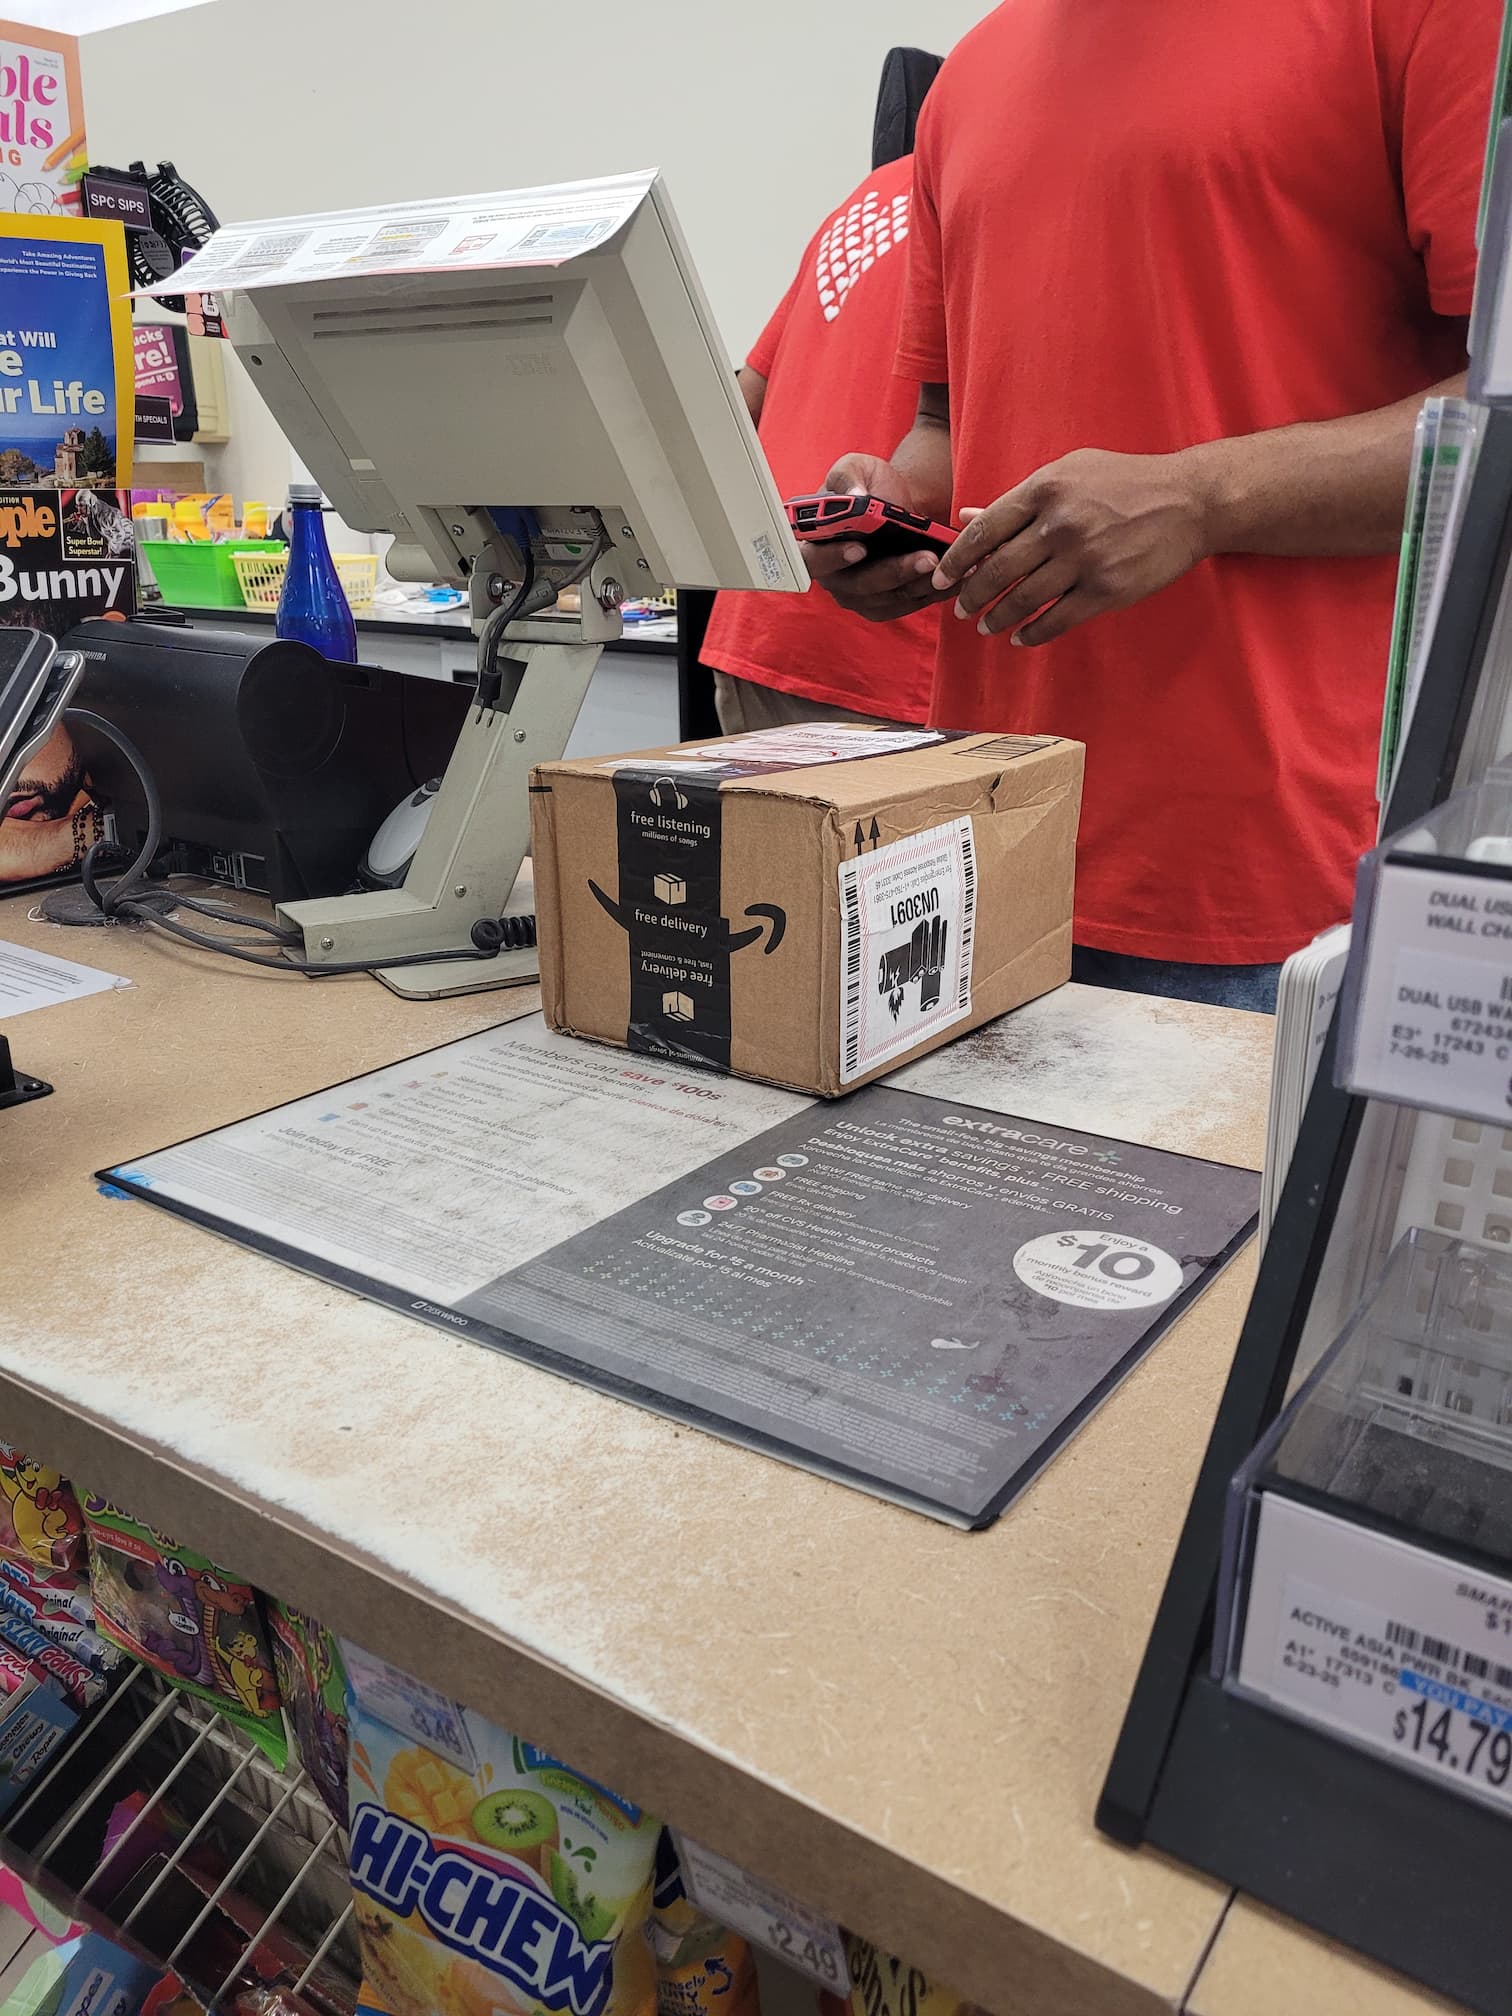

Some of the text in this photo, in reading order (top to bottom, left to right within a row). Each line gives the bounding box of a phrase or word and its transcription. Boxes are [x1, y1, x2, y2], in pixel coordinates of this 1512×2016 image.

[91, 193, 145, 213] SPC SIPS
[22, 250, 96, 262] Take Amazing Adventures
[62, 262, 97, 270] Destinations
[19, 331, 56, 348] Will
[28, 380, 105, 414] Life
[142, 415, 168, 424] SPECIALS
[66, 536, 87, 546] Super
[68, 546, 102, 555] Superstar!
[0, 554, 124, 608] Bunny
[631, 810, 712, 838] free listening
[641, 830, 698, 848] millions of songs
[891, 887, 939, 928] UN3091
[1429, 891, 1478, 913] DUAL
[635, 908, 708, 938] free delivery
[1427, 914, 1477, 935] WALL
[640, 950, 676, 964] convenient
[683, 957, 698, 968] free
[699, 960, 713, 970] fast,
[640, 959, 713, 987] free delivery
[1398, 986, 1441, 1009] DUAL
[1447, 995, 1482, 1015] USB
[504, 1040, 584, 1065] Members
[583, 1062, 618, 1074] can
[619, 1071, 666, 1085] save
[278, 1127, 307, 1139] Join
[304, 1135, 342, 1151] today
[339, 1146, 361, 1156] for
[898, 1118, 921, 1127] The
[983, 1138, 1058, 1161] big-savings
[1059, 1158, 1145, 1182] membership
[943, 1116, 1088, 1155] extracare
[823, 1128, 861, 1142] Enjoy
[938, 1156, 1001, 1178] benefits,
[1003, 1175, 1039, 1187] plus
[836, 1121, 897, 1141] Unlock
[899, 1138, 948, 1154] extra
[951, 1150, 1021, 1172] savings
[1041, 1171, 1093, 1190] FREE
[1095, 1186, 1182, 1215] shipping
[792, 1176, 866, 1200] FREE shipping
[808, 1137, 891, 1163] Desbloquea
[893, 1160, 926, 1172] más
[927, 1169, 984, 1187] ahorros
[1052, 1200, 1114, 1221] GRATIS
[814, 1163, 845, 1175] NEW!
[844, 1171, 874, 1182] FREE
[927, 1194, 972, 1209] delivery
[768, 1190, 798, 1201] FREE
[812, 1203, 856, 1219] delivery
[645, 1230, 704, 1253] Upgrade
[704, 1249, 728, 1260] for
[717, 1221, 855, 1266] 24/7 Pharmacist Helpline
[781, 1216, 807, 1227] CVS
[846, 1235, 883, 1249] brand
[880, 1246, 936, 1266] products
[1099, 1234, 1137, 1249] Enjoy
[1058, 1235, 1154, 1280] $10
[692, 1259, 717, 1269] por
[743, 1275, 772, 1288] mes
[1026, 1257, 1152, 1297] monthly bonus reward
[1290, 1606, 1472, 1693] ACTIVE ASIA PWR BK
[1325, 1655, 1373, 1686] 17313
[1414, 1674, 1512, 1726] YOU PAY
[13, 1724, 45, 1759] Chewy
[31, 1730, 58, 1766] Ropes
[1393, 1699, 1512, 1786] $14.79
[352, 1806, 614, 2011] HI-CHEW
